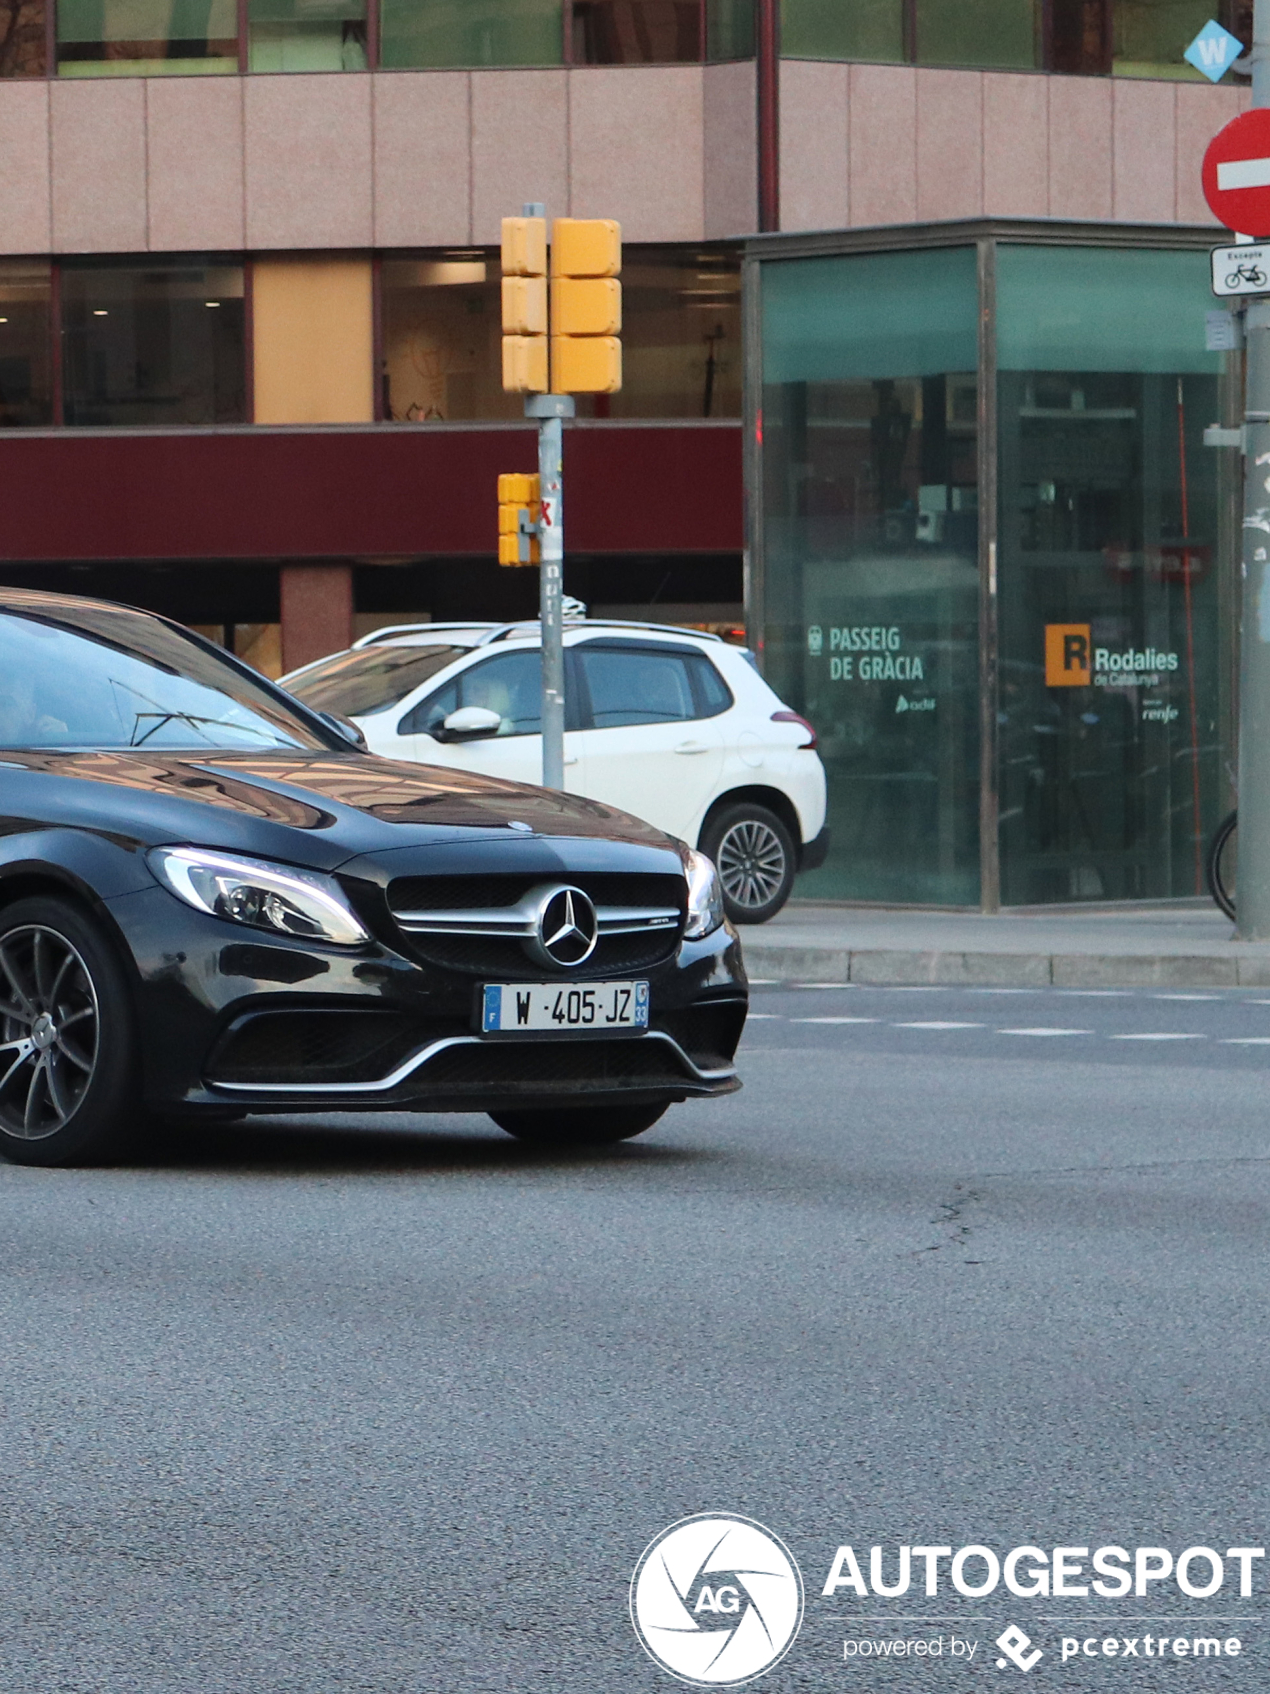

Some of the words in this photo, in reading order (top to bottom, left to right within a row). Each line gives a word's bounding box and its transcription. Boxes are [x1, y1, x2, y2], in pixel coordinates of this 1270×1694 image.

[1197, 36, 1228, 66] W
[830, 626, 901, 651] PASSEIG
[1063, 633, 1089, 671] R
[1094, 647, 1179, 672] Rodalies
[830, 656, 853, 680] DE
[858, 651, 924, 681] GRÀCIA
[488, 1012, 496, 1023] F
[635, 1005, 648, 1023] 33
